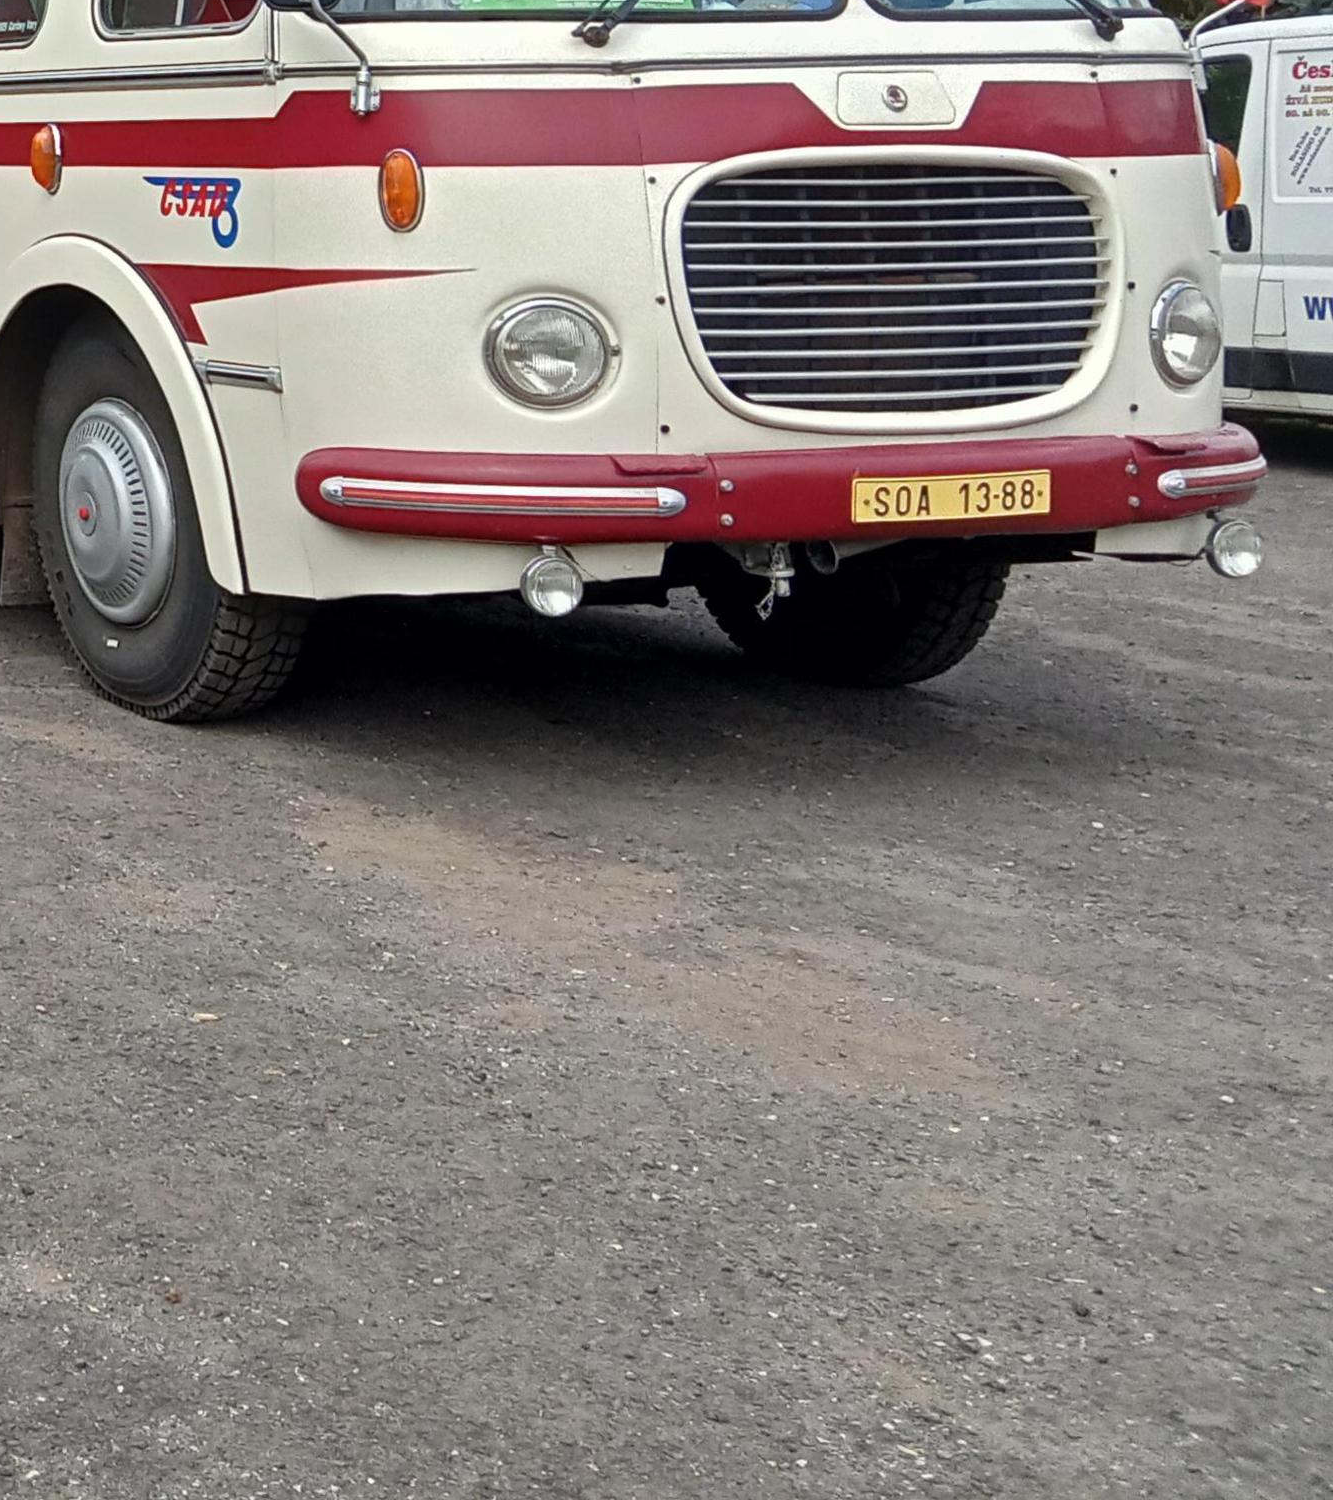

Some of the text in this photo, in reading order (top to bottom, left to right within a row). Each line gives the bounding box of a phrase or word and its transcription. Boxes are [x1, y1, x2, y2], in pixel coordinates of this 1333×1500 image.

[1292, 55, 1333, 80] Čes
[873, 479, 1034, 517] SOA 13-88
